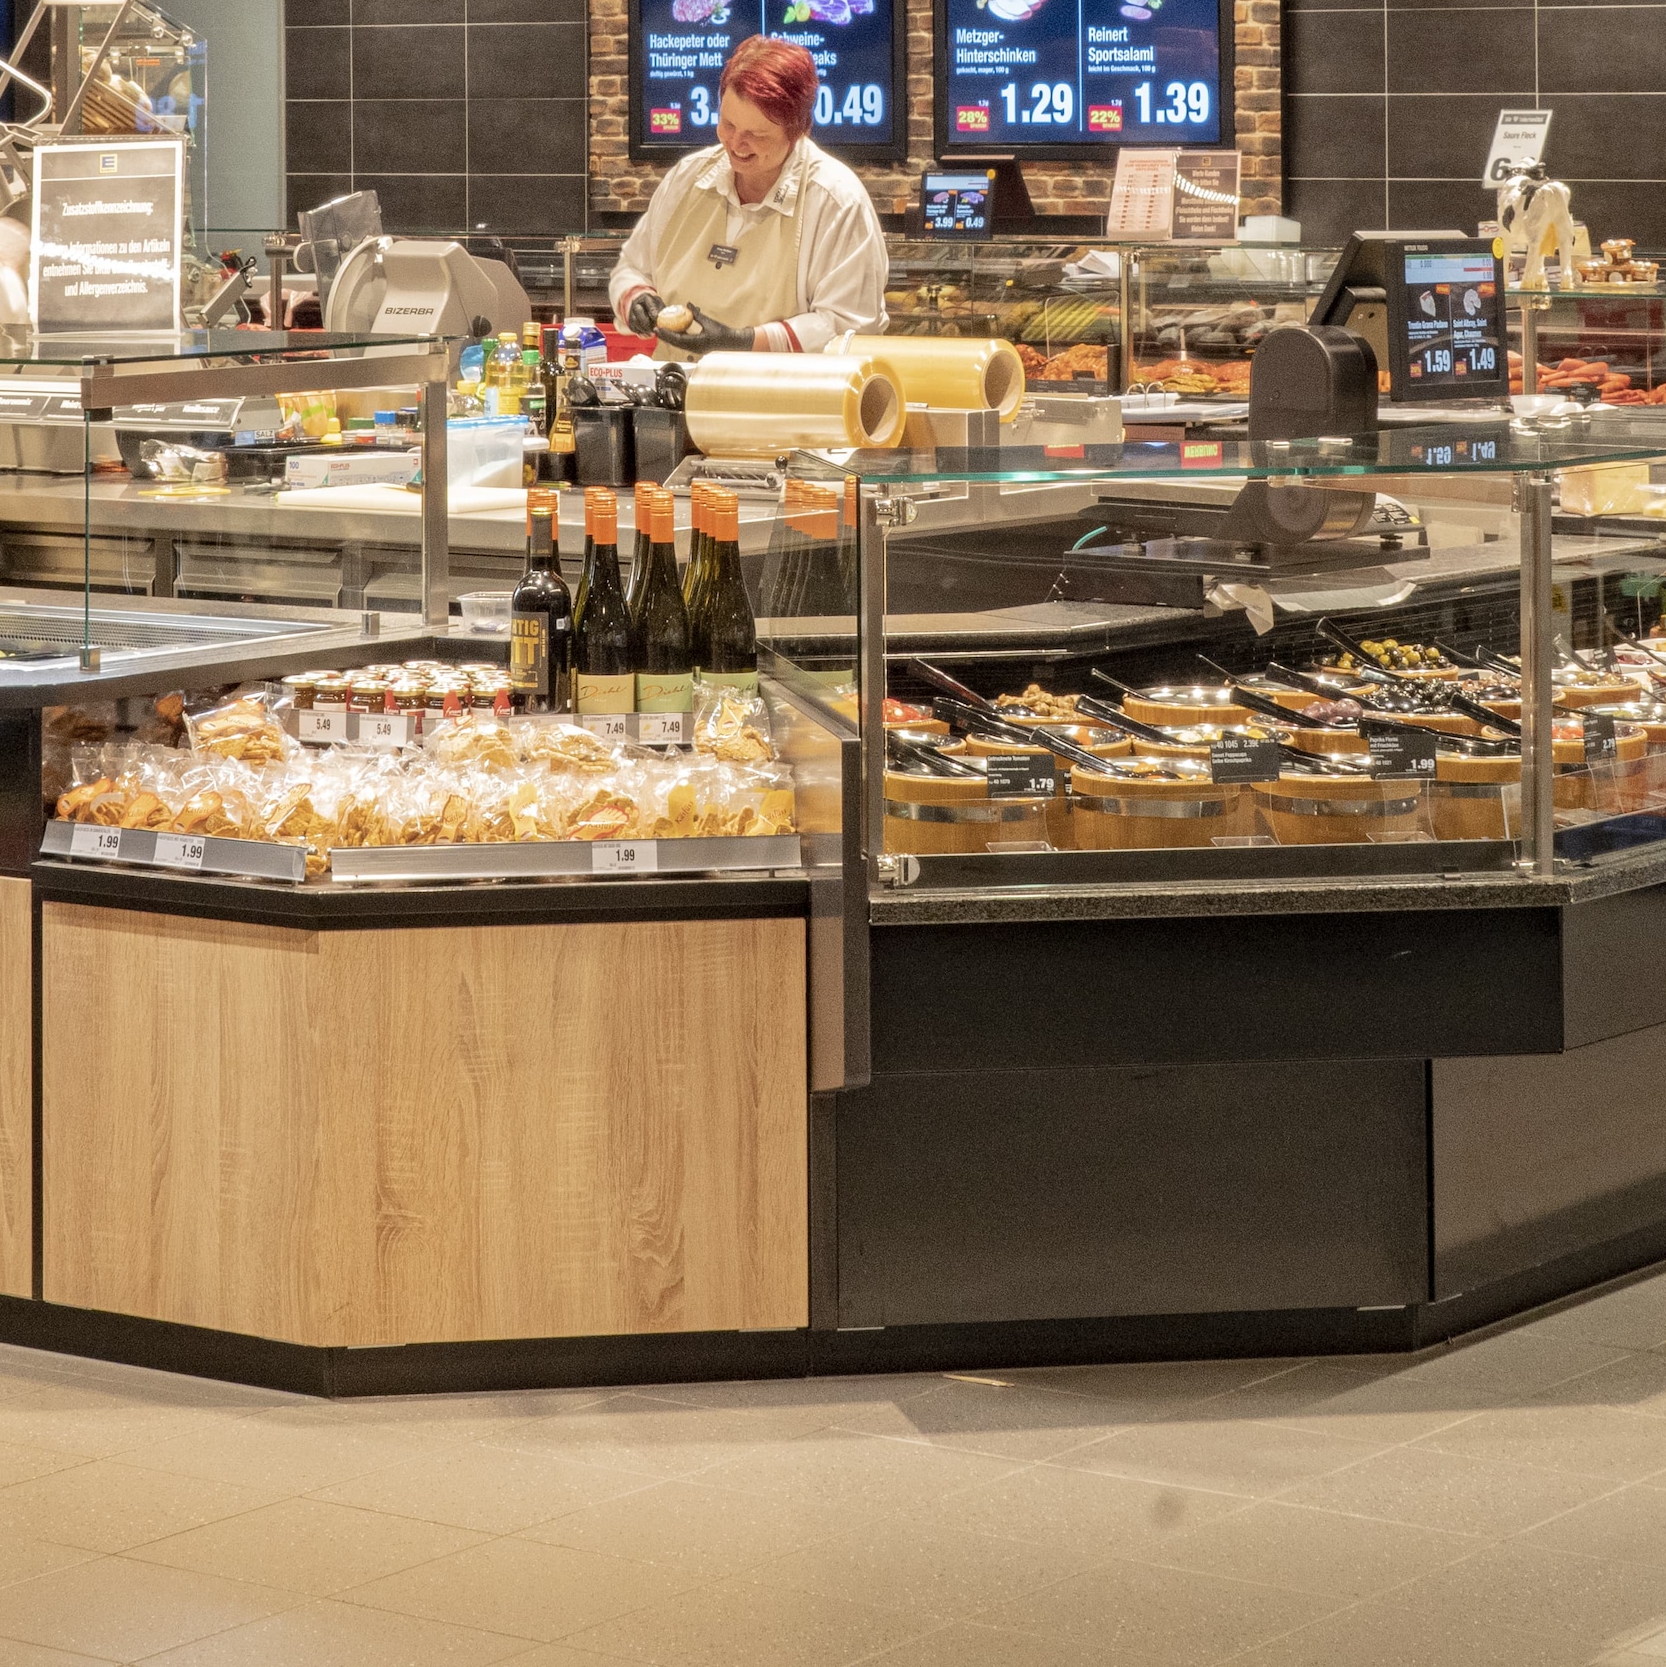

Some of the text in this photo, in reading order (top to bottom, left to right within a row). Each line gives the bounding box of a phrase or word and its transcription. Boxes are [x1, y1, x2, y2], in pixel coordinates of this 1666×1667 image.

[955, 28, 1004, 46] Metzger-
[1087, 26, 1129, 42] Reinert
[649, 33, 731, 51] Hackepeter oder
[649, 51, 724, 70] Thüringer Mett
[955, 47, 1037, 64] Hinterschinken
[1087, 45, 1155, 64] Sportsalami
[689, 85, 720, 126] 3.
[814, 84, 884, 126] 0.49
[1000, 81, 1075, 124] 1.29
[1134, 81, 1210, 124] 1.39
[652, 112, 680, 126] 33%
[958, 110, 988, 124] 28%
[1090, 110, 1121, 124] 22%
[118, 242, 128, 255] zu
[128, 240, 142, 254] den
[142, 238, 171, 254] Artikeln
[42, 263, 81, 278] entnehmen
[64, 279, 149, 298] und Allergenverzeichnis.
[384, 306, 434, 316] BIZERBA
[1424, 348, 1451, 374] 1.59
[1469, 347, 1496, 371] 1.49
[589, 366, 624, 379] ECO-PLUS
[254, 430, 275, 439] SALZ
[289, 461, 300, 470] 100
[316, 718, 331, 731] 5.49
[376, 723, 392, 736] 5.49
[605, 722, 625, 735] 7.49
[661, 720, 680, 733] 7.49
[1410, 759, 1435, 770] 1.99
[1029, 778, 1055, 789] 1.79
[98, 834, 118, 849] 1.99
[181, 844, 203, 859] 1.99
[615, 848, 636, 862] 1.99
